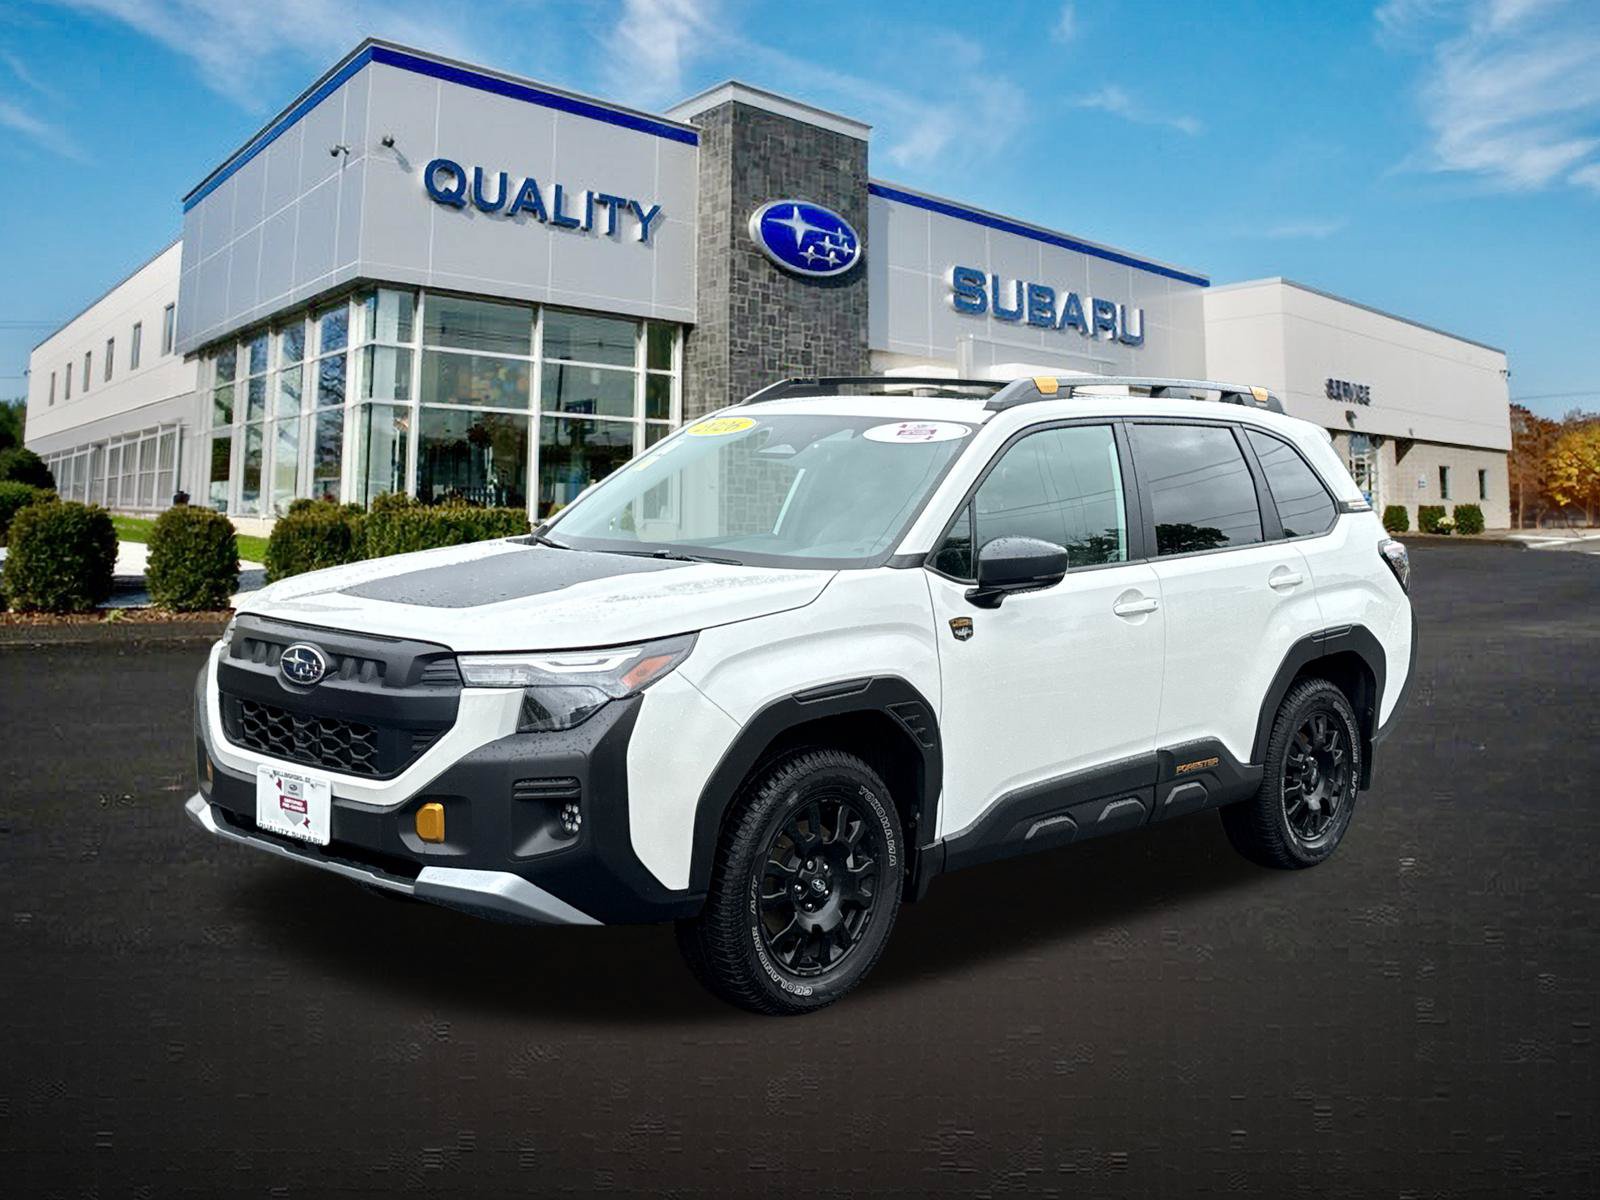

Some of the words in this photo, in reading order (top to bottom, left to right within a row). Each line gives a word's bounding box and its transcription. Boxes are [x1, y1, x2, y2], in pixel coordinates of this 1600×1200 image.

[423, 157, 662, 243] QUALITY
[945, 265, 1145, 347] SUBARU
[1325, 378, 1371, 406] SERVICE
[258, 822, 289, 835] QUALITY
[291, 831, 324, 845] SUBARU
[858, 785, 897, 867] YOKOHAMA
[751, 926, 814, 996] GEOLANDAR
